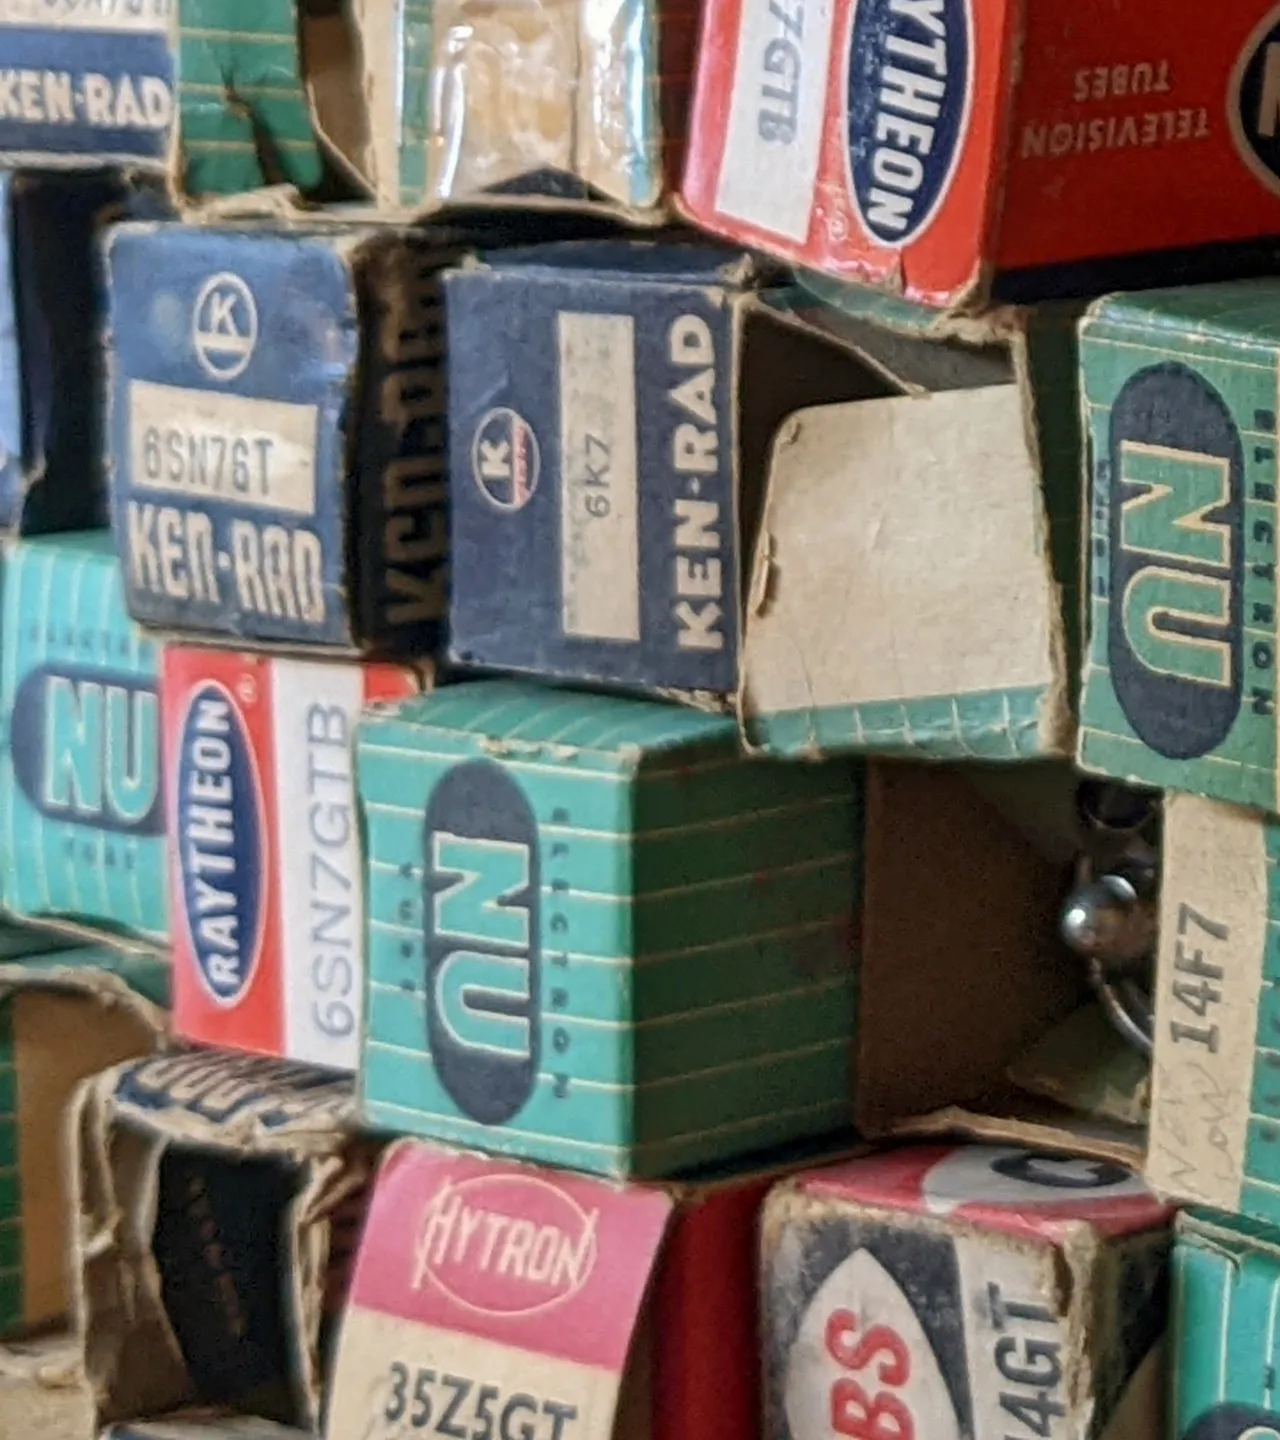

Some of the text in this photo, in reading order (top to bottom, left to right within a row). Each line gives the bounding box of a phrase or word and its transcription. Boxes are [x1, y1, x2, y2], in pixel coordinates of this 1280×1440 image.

[1021, 107, 1210, 160] TELEVISION
[1073, 60, 1171, 102] TUBES
[584, 432, 613, 521] 6K7
[1119, 440, 1233, 689] NU
[43, 673, 159, 826] NU
[187, 696, 242, 988] RAYTHEON
[305, 700, 357, 1041] 6SN7GTB
[431, 830, 533, 1060] NU
[1170, 902, 1233, 1056] 14F7
[412, 1173, 598, 1292] HYTRON
[383, 1360, 578, 1440] 35Z5GT
